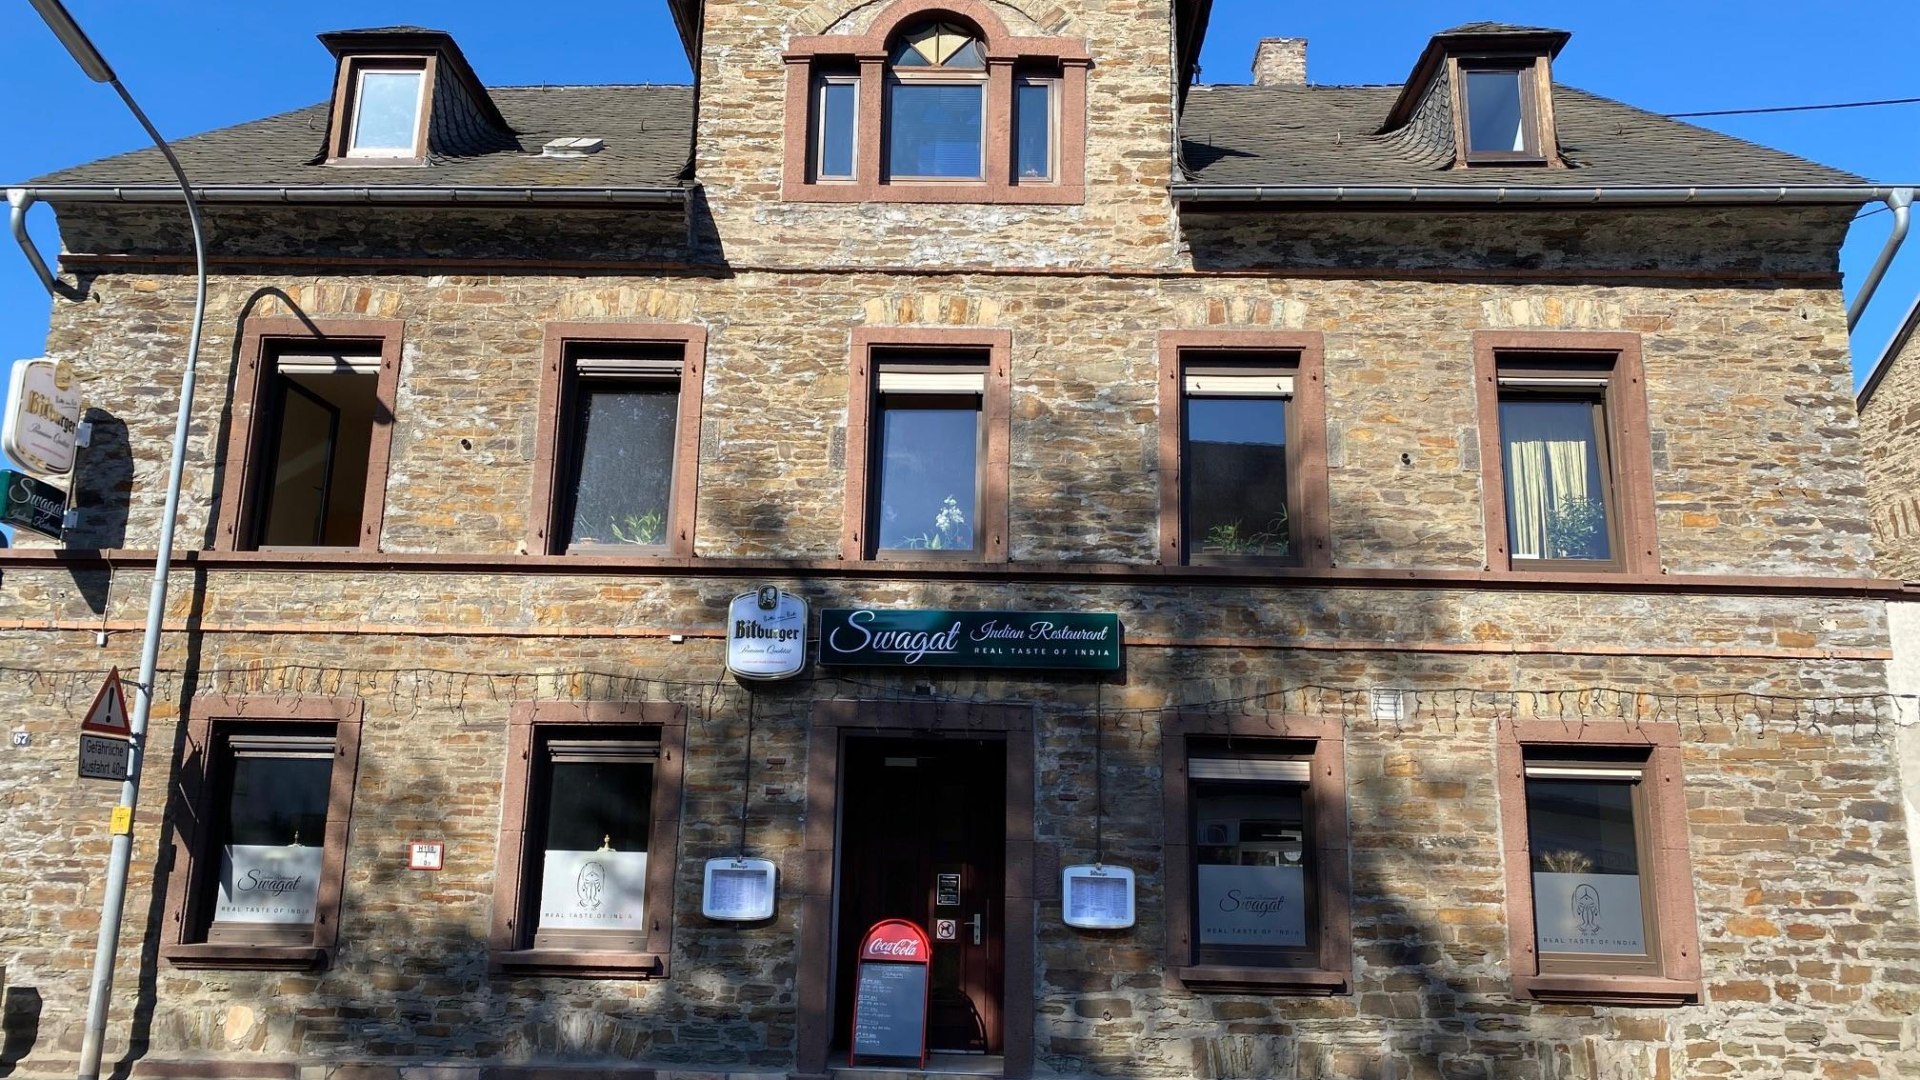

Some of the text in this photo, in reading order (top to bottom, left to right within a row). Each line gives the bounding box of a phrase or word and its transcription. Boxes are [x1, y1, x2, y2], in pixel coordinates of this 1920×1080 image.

[9, 477, 66, 519] Swagat
[829, 610, 961, 664] Swagat
[970, 619, 1109, 641] Indian Restaurant
[14, 732, 29, 745] 67
[86, 739, 124, 757] Gefährliche
[81, 759, 110, 775] Ausfahrt
[237, 868, 302, 897] Swagat
[1219, 889, 1285, 918] Swagat
